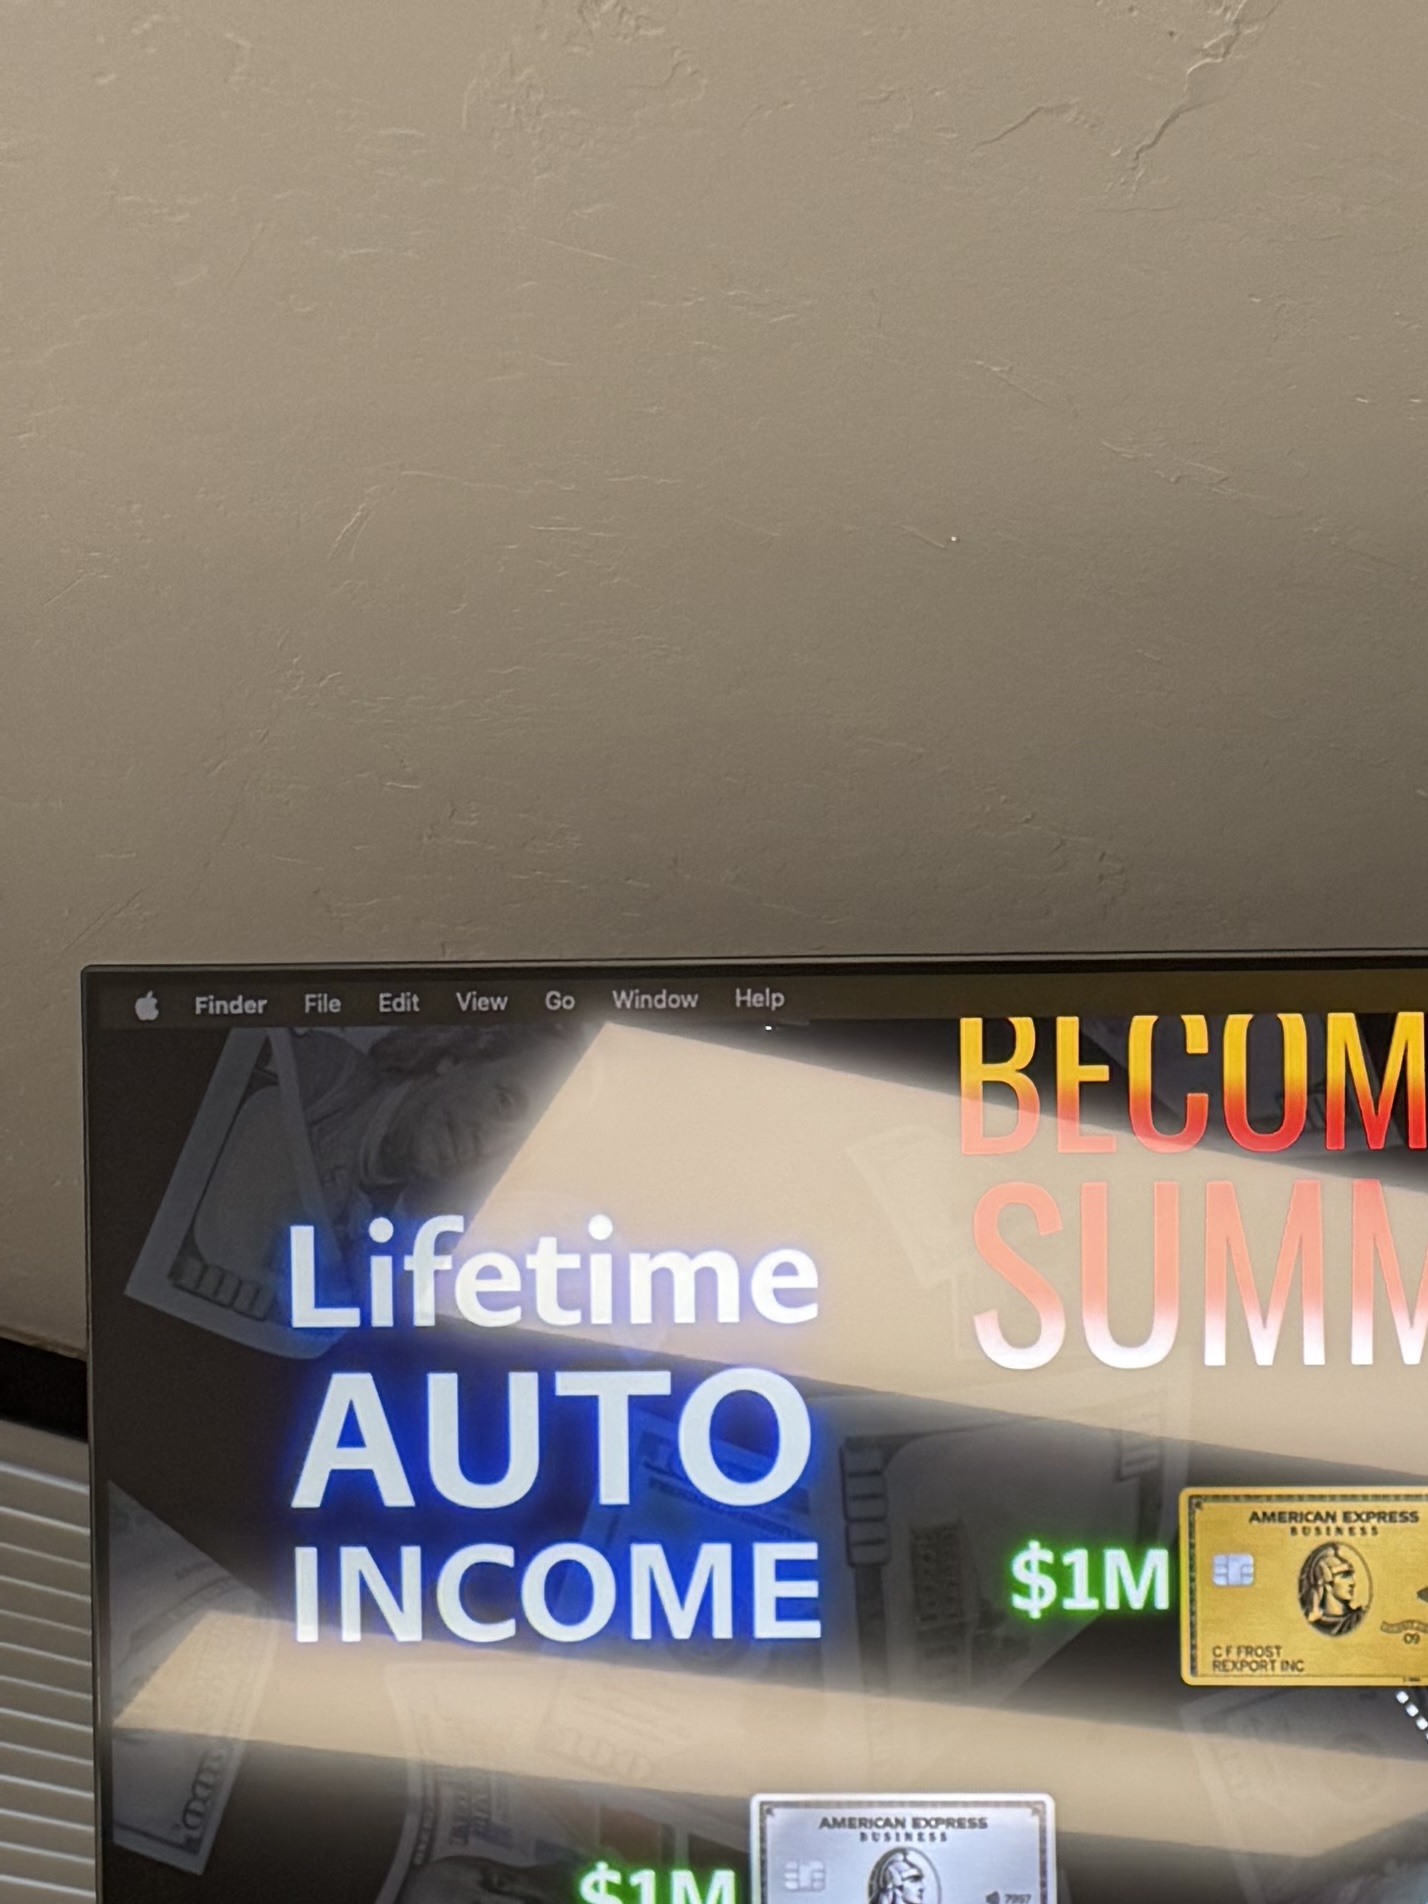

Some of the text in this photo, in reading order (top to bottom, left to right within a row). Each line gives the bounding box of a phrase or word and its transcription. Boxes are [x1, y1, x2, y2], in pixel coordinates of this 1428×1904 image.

[195, 988, 785, 1015] Finder File Edit View Go Window Help
[290, 1214, 820, 1329] Lifetime
[290, 1366, 813, 1510] AUTO
[1249, 1510, 1420, 1524] AMERICAN EXPRESS
[1290, 1525, 1378, 1536] BUSINESS
[1010, 1540, 1170, 1619] $1M
[293, 1541, 823, 1644] INCOME
[1212, 1645, 1282, 1658] C F FROST
[1212, 1659, 1305, 1673] REXPORT INC
[818, 1816, 988, 1830] AMERICAN EXPRESS
[860, 1831, 948, 1843] BUSINESS
